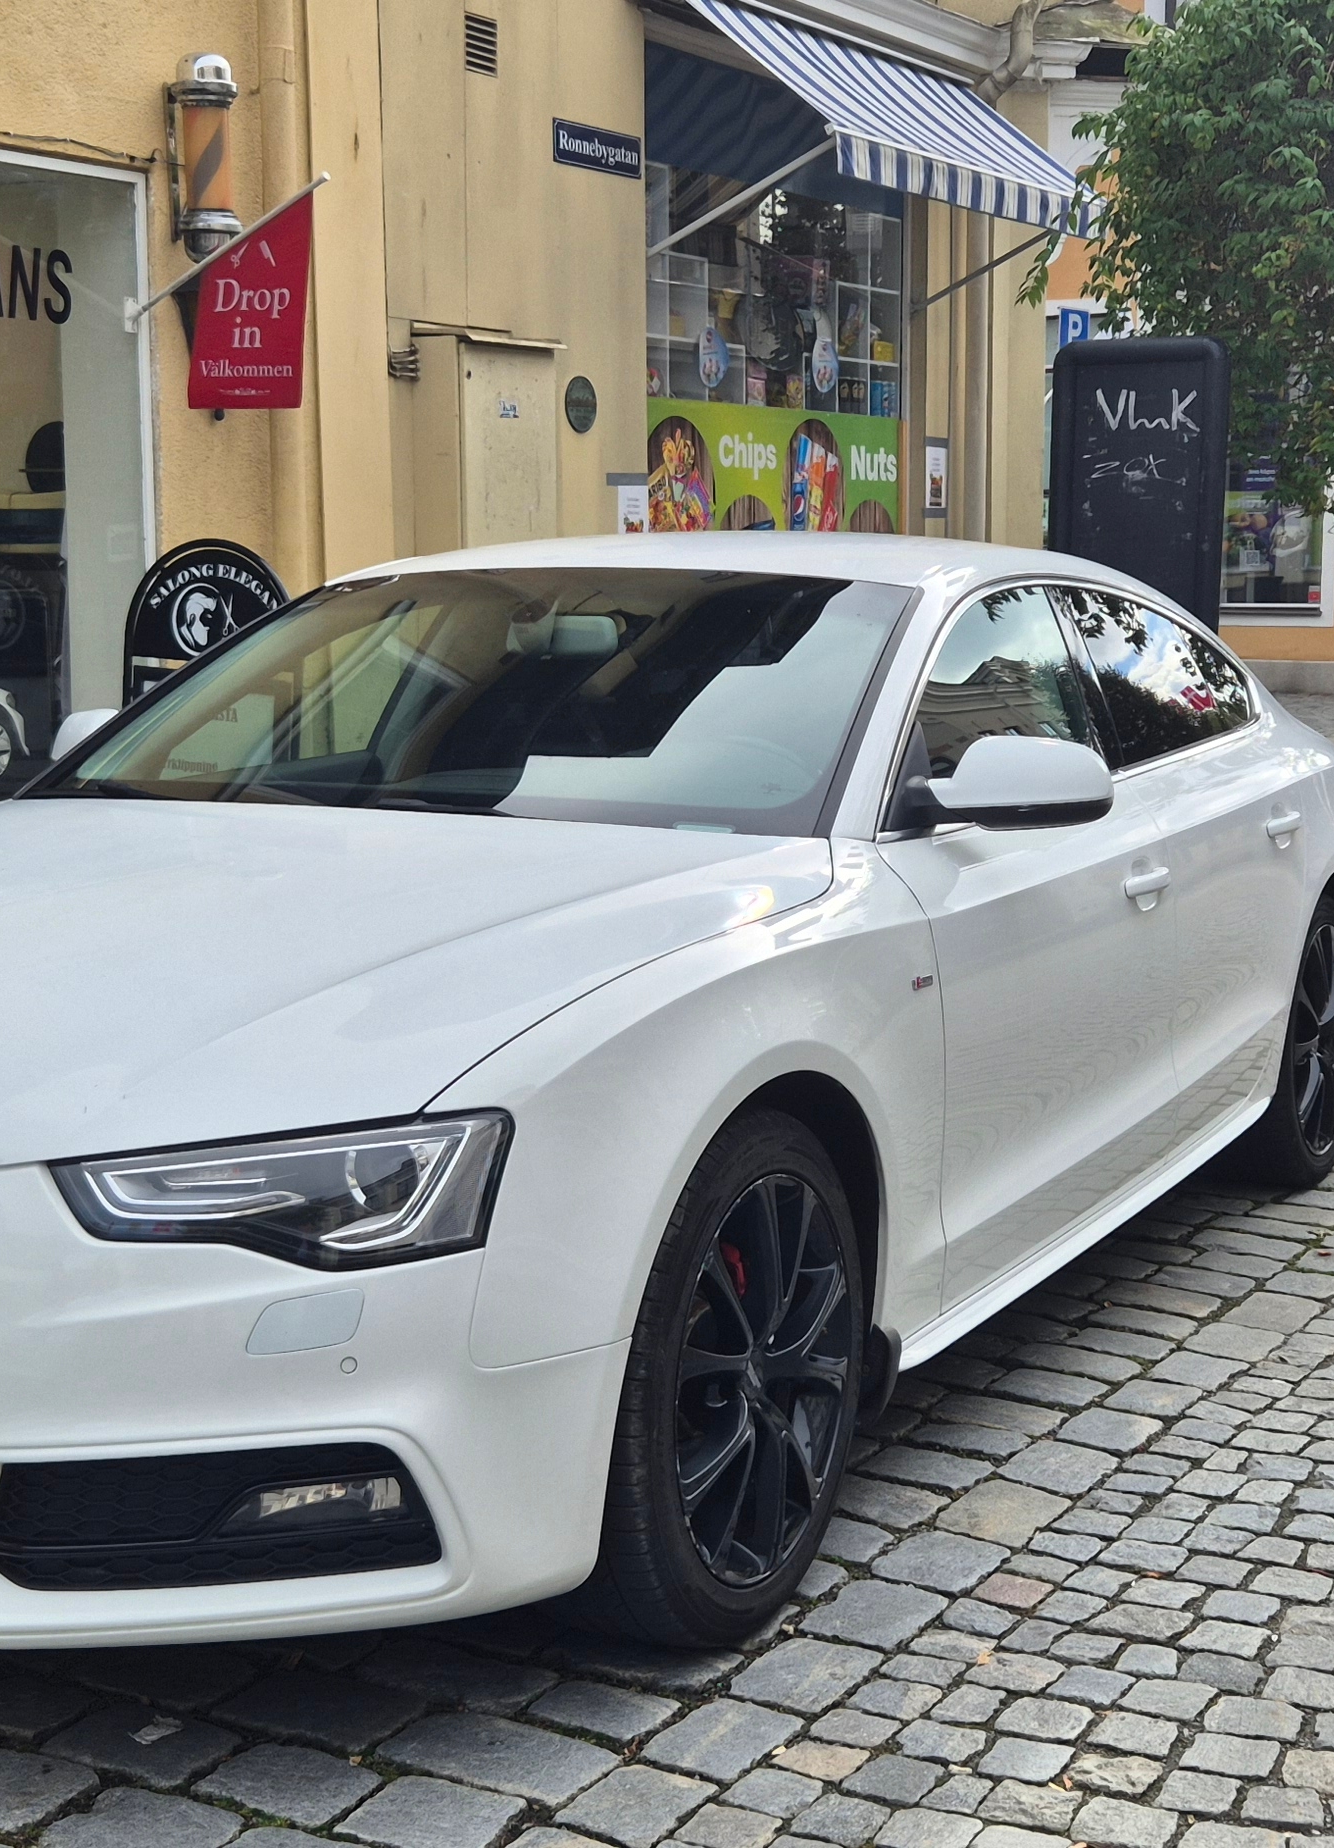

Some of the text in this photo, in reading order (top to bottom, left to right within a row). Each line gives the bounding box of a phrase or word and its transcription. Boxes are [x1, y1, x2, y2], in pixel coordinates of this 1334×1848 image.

[558, 129, 639, 167] Ronnebygatan
[214, 278, 291, 319] Drop
[232, 316, 262, 348] in
[1068, 313, 1083, 343] P
[200, 359, 293, 378] Välkommen
[719, 431, 778, 480] Chips
[850, 444, 897, 483] Nuts
[149, 563, 279, 610] SALONG ELEGAN
